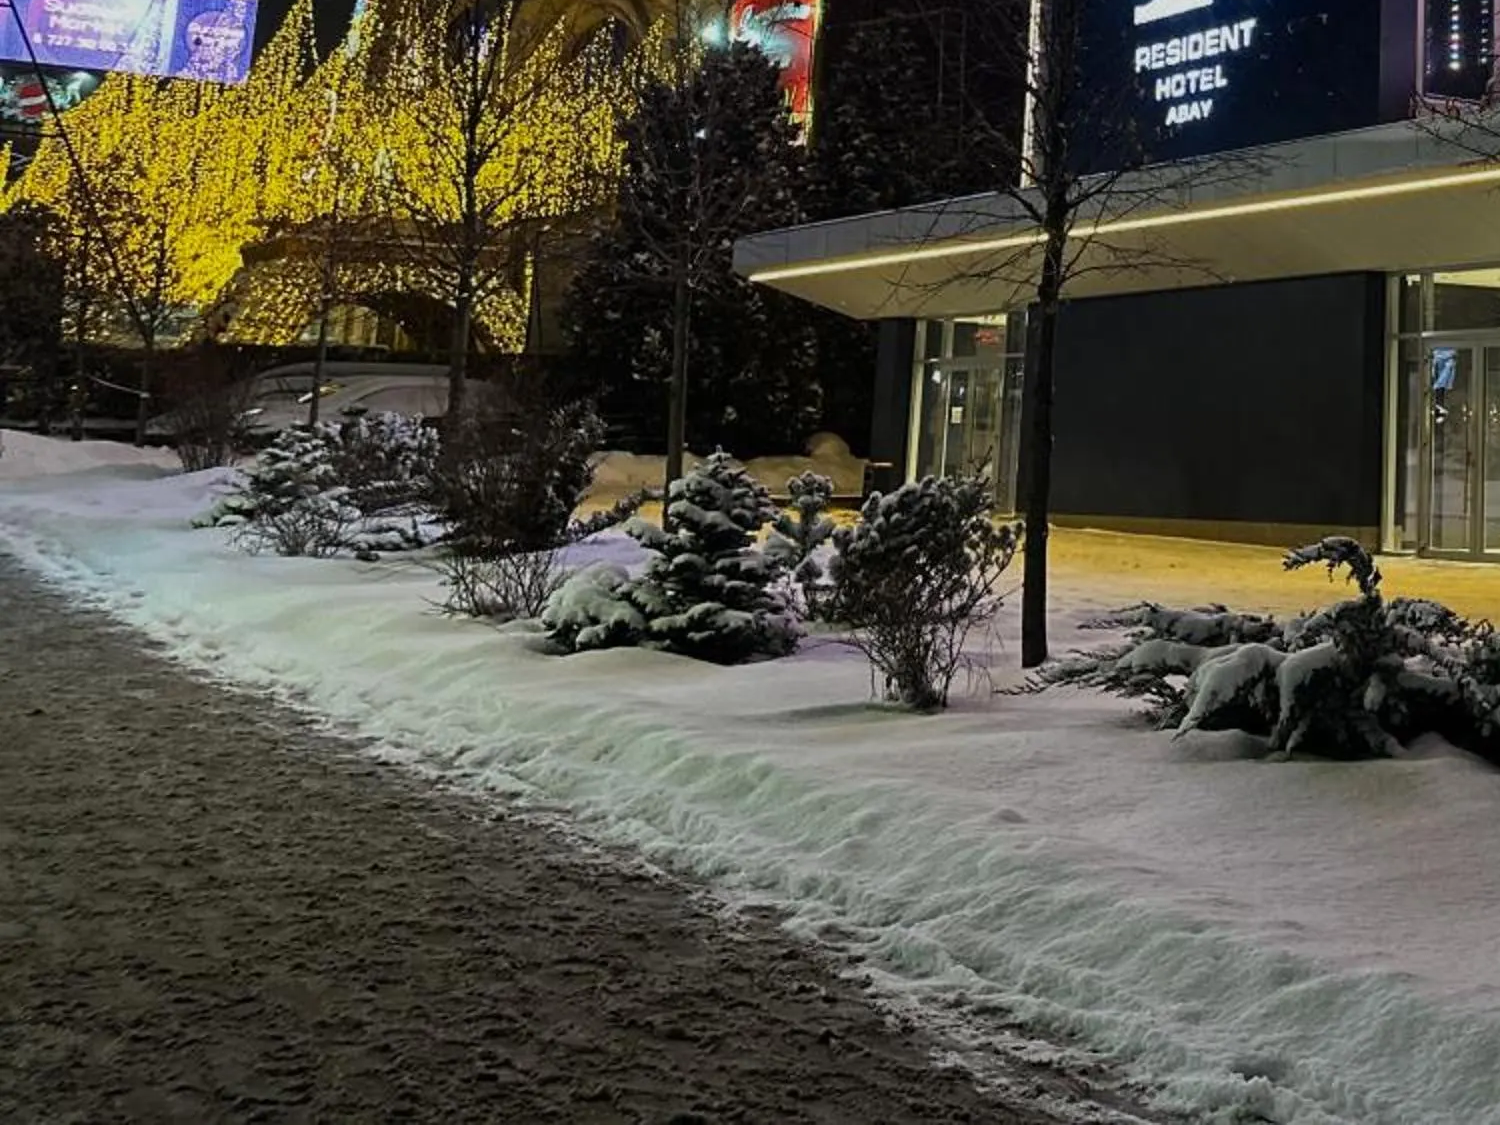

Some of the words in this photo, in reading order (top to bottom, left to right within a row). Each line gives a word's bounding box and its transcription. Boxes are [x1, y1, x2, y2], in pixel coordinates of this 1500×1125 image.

[1134, 17, 1258, 73] RESIDENT
[1154, 64, 1229, 101] HOTEL
[1164, 98, 1213, 126] ABAY
